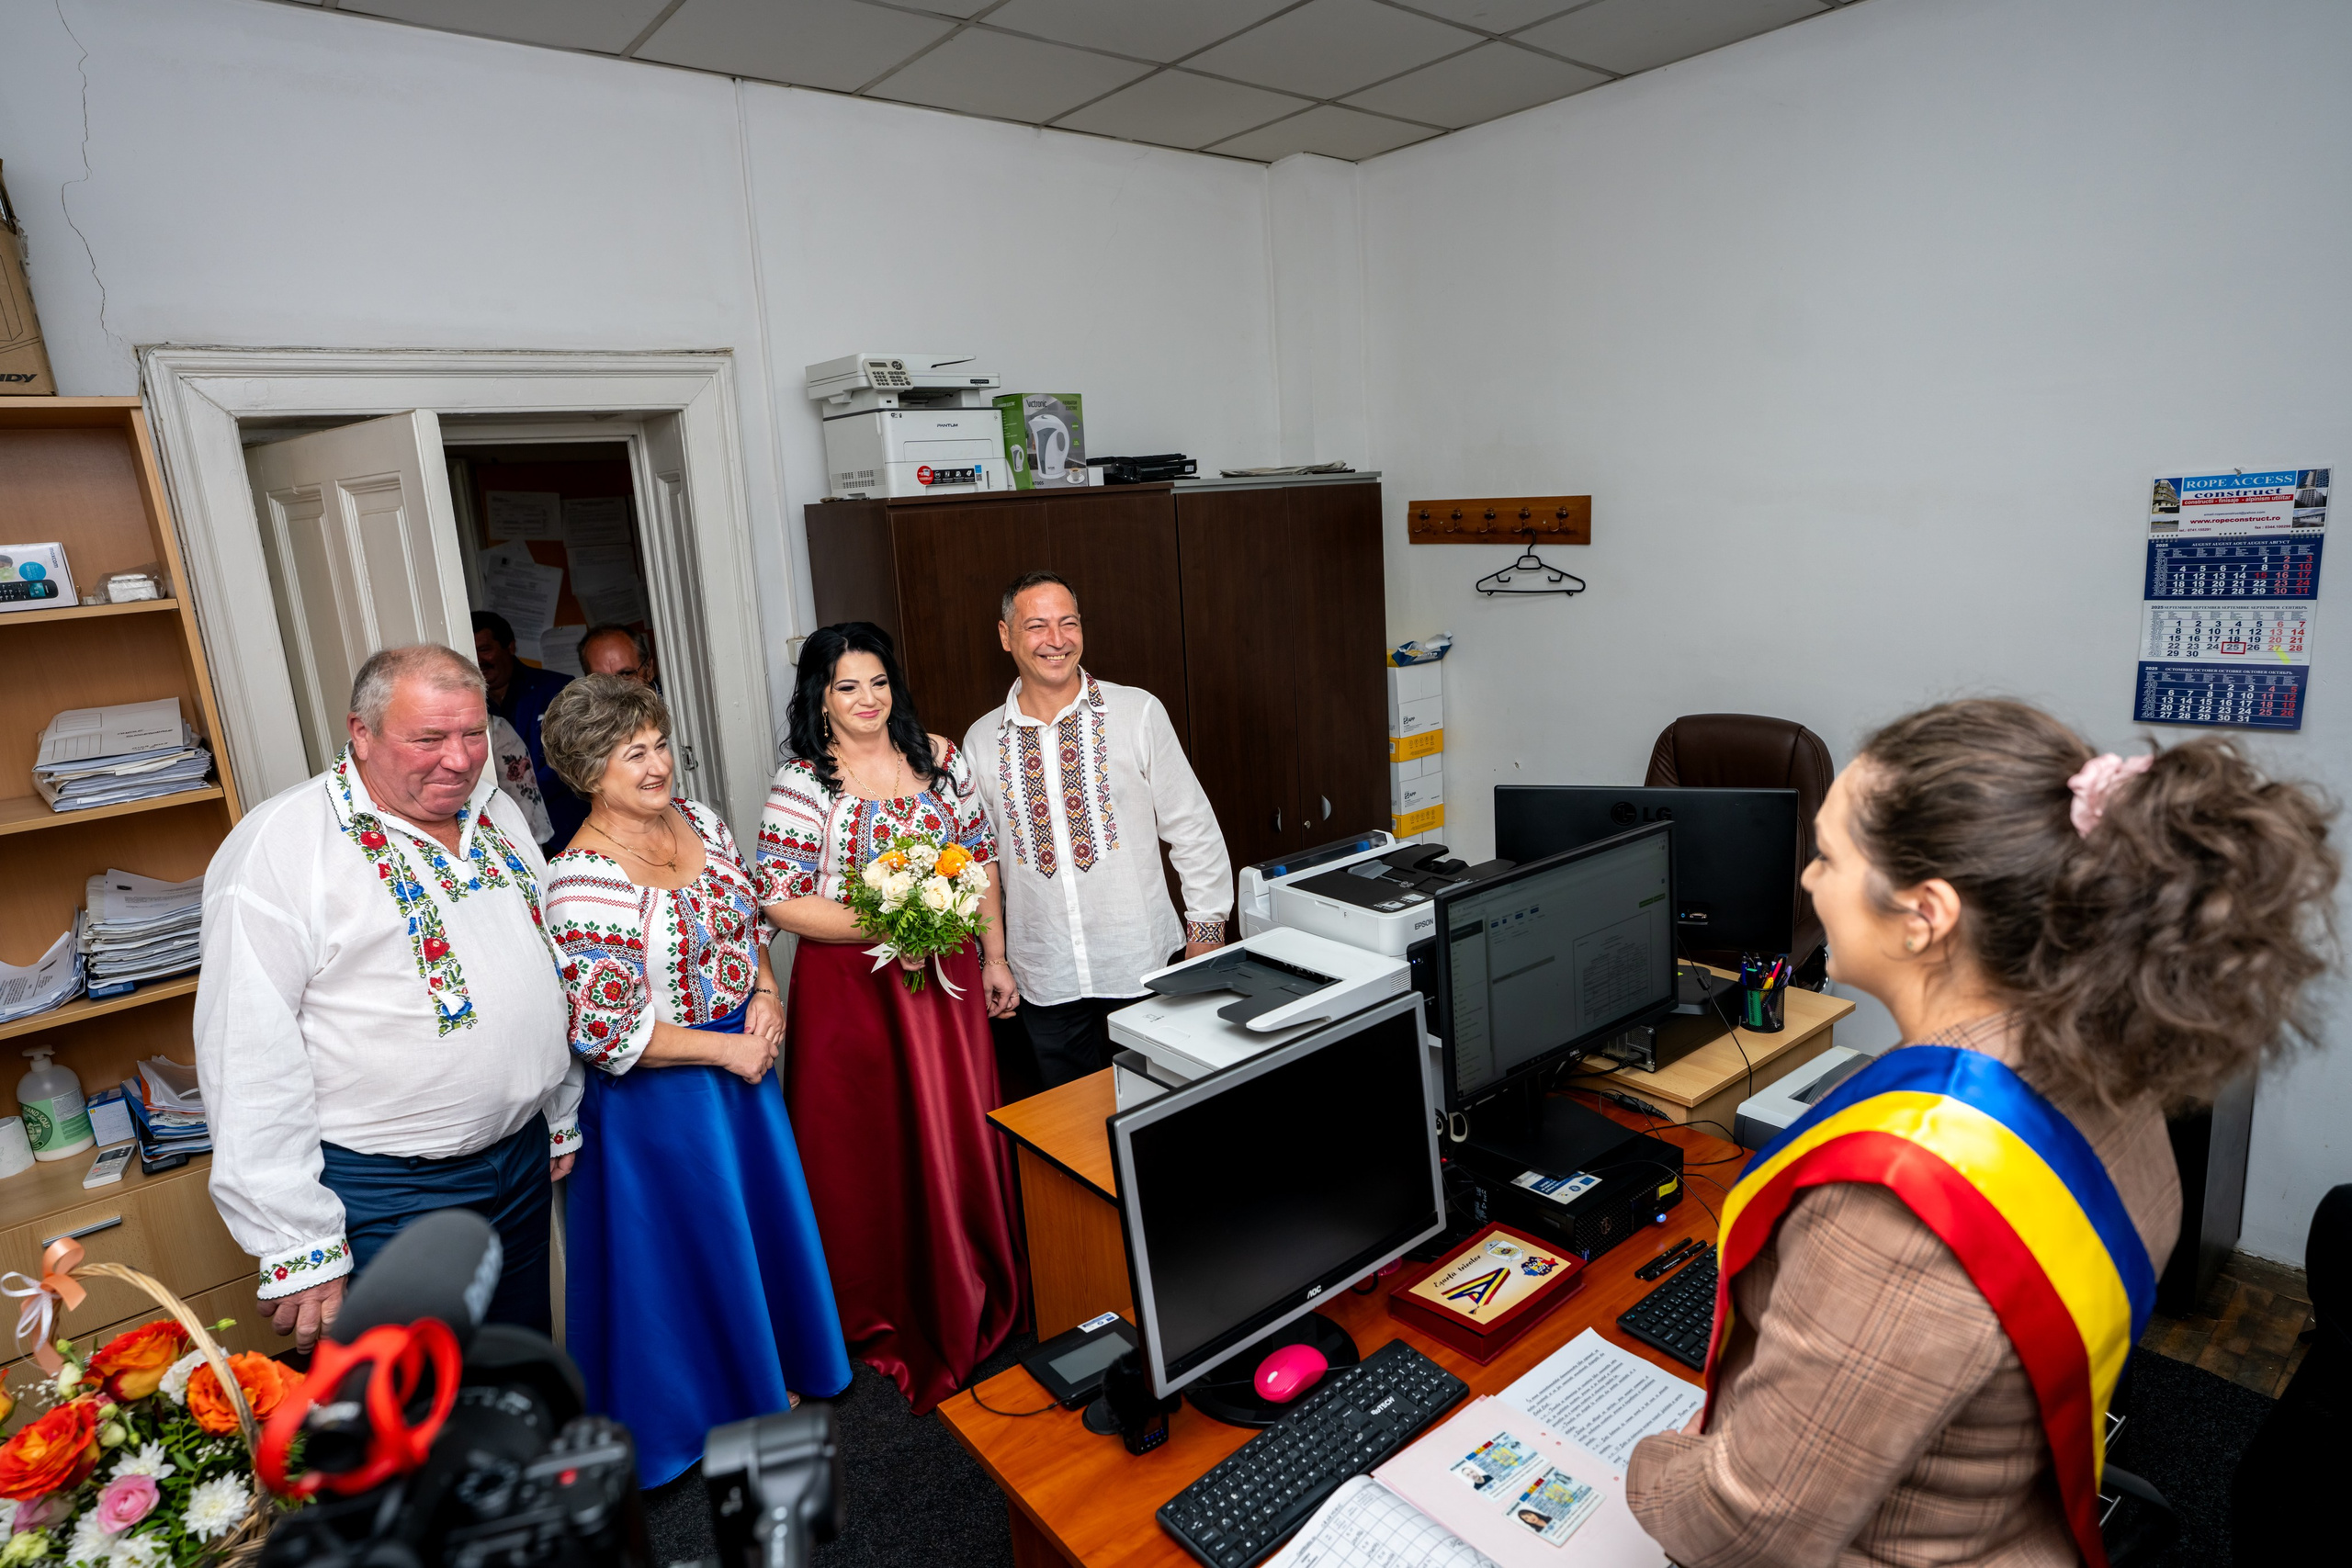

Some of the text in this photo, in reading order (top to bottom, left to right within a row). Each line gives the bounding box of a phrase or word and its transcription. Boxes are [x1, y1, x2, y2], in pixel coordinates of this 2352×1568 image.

[2187, 474, 2293, 489] ROPE ACCESS
[2194, 487, 2282, 499] construct
[2189, 515, 2280, 525] www.ropeconstruct.ro
[1643, 807, 1672, 822] LG
[1415, 918, 1434, 930] EPSON
[38, 1114, 51, 1129] SOAP
[1458, 1254, 1481, 1272] tricolor
[1306, 1285, 1322, 1299] AOC
